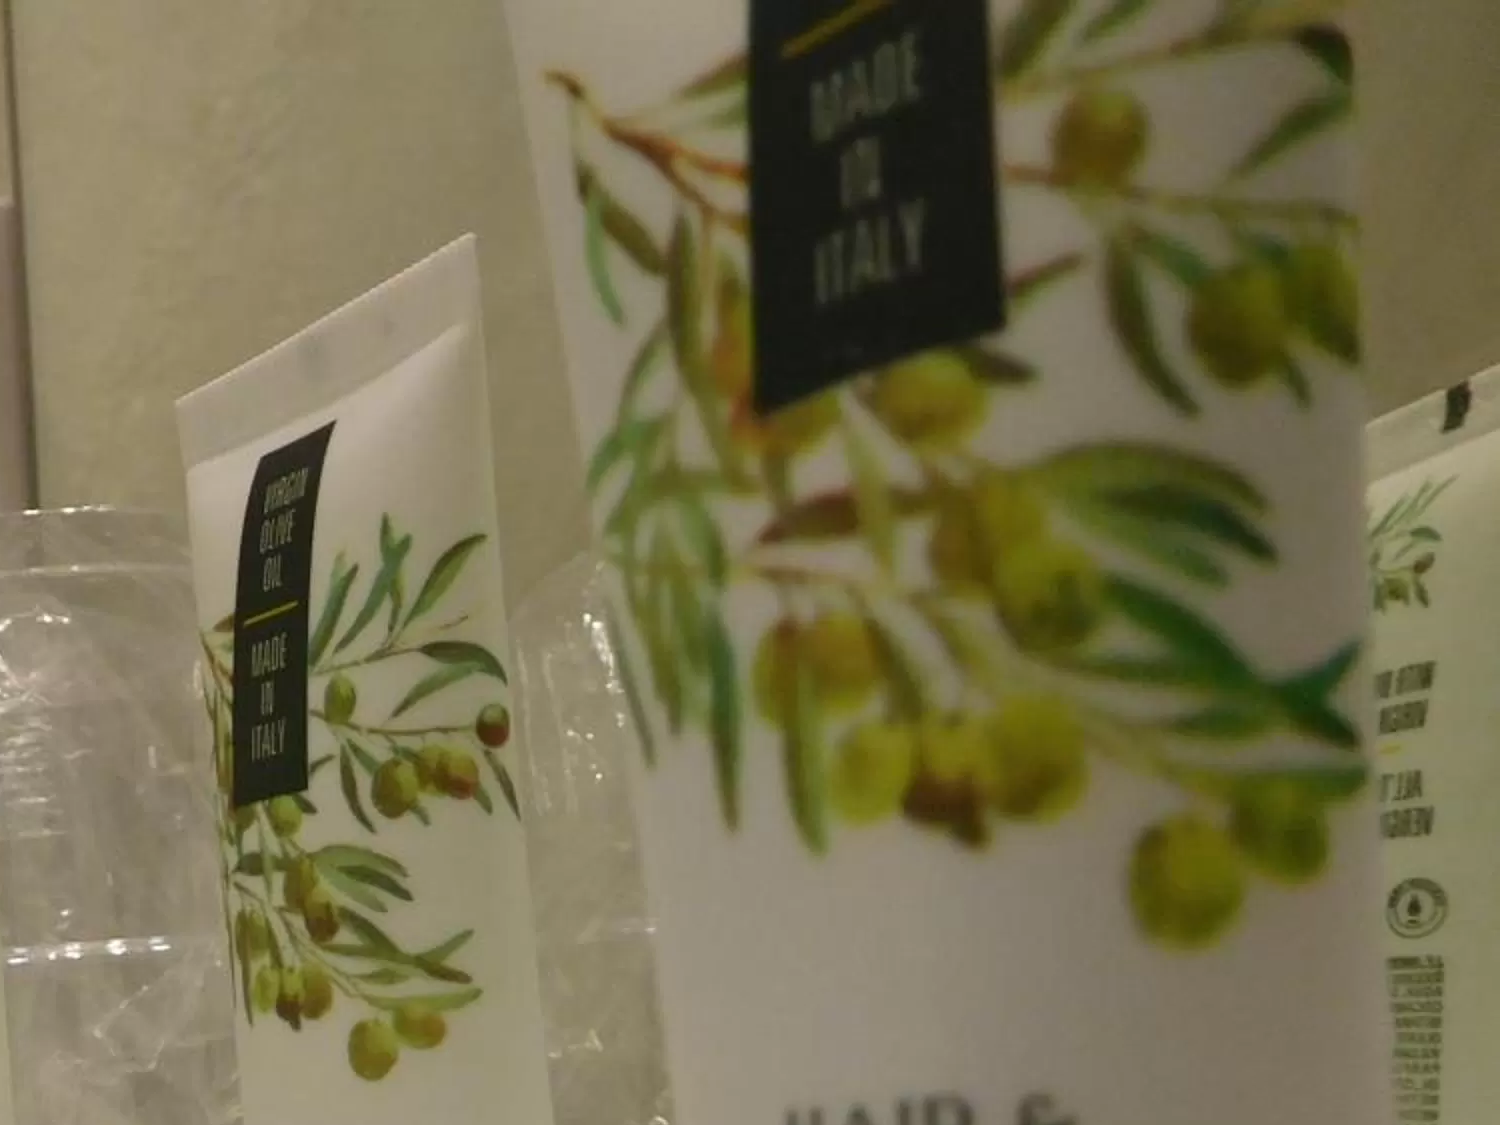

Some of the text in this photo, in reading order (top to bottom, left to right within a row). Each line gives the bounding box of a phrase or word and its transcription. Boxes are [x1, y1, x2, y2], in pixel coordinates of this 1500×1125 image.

[259, 507, 297, 555] OLIVE
[262, 553, 282, 593] OIL
[251, 631, 288, 678] MADE
[260, 680, 275, 717] IN
[251, 716, 287, 763] ITALY
